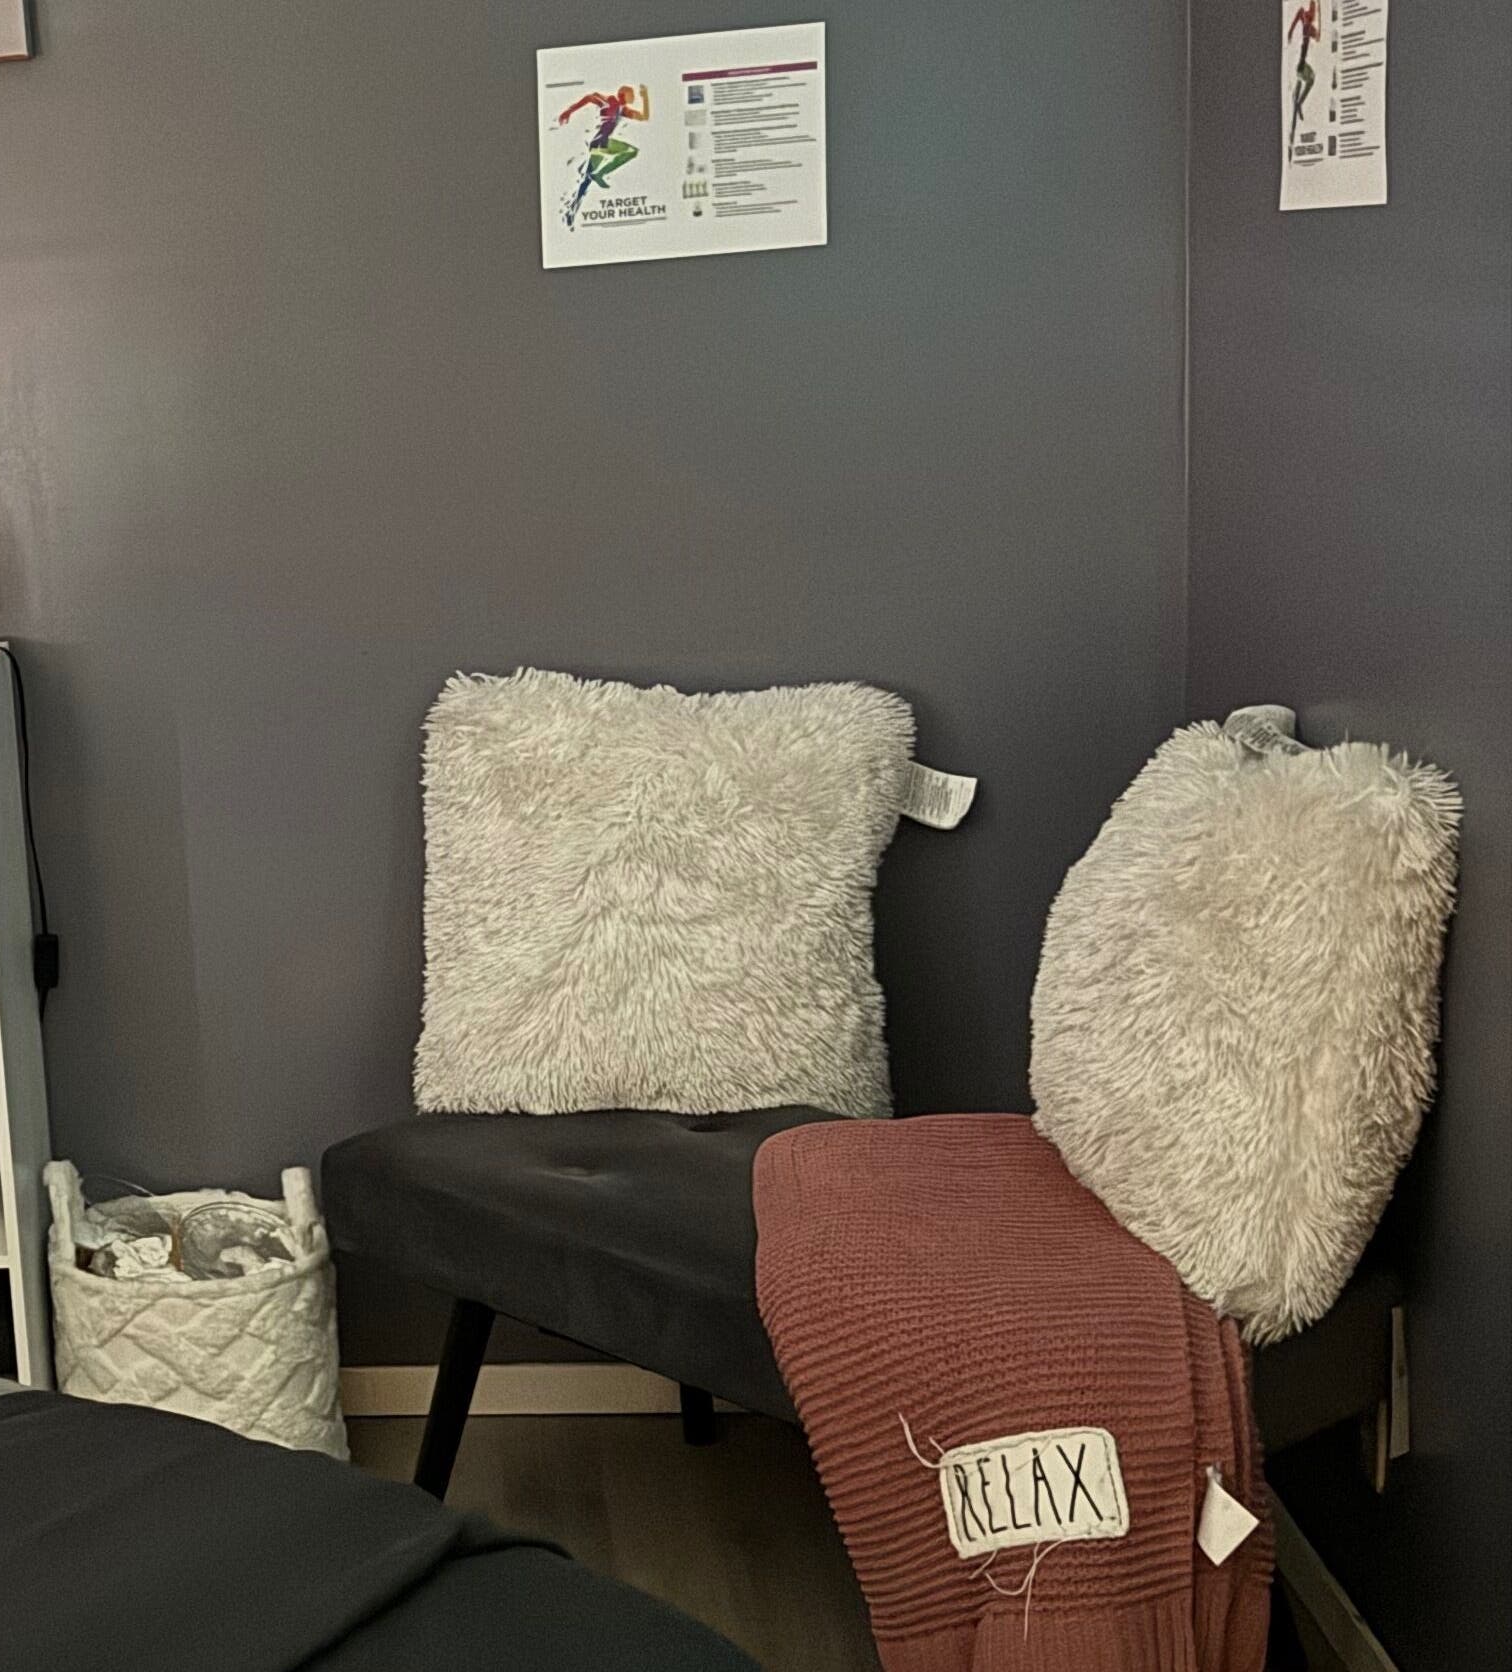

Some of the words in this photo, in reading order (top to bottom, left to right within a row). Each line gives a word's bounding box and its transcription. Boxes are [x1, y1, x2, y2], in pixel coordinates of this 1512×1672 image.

[600, 196, 647, 209] TARGET
[582, 209, 615, 220] YOUR
[619, 205, 666, 217] HEALTH
[954, 1443, 1104, 1542] RELAX
